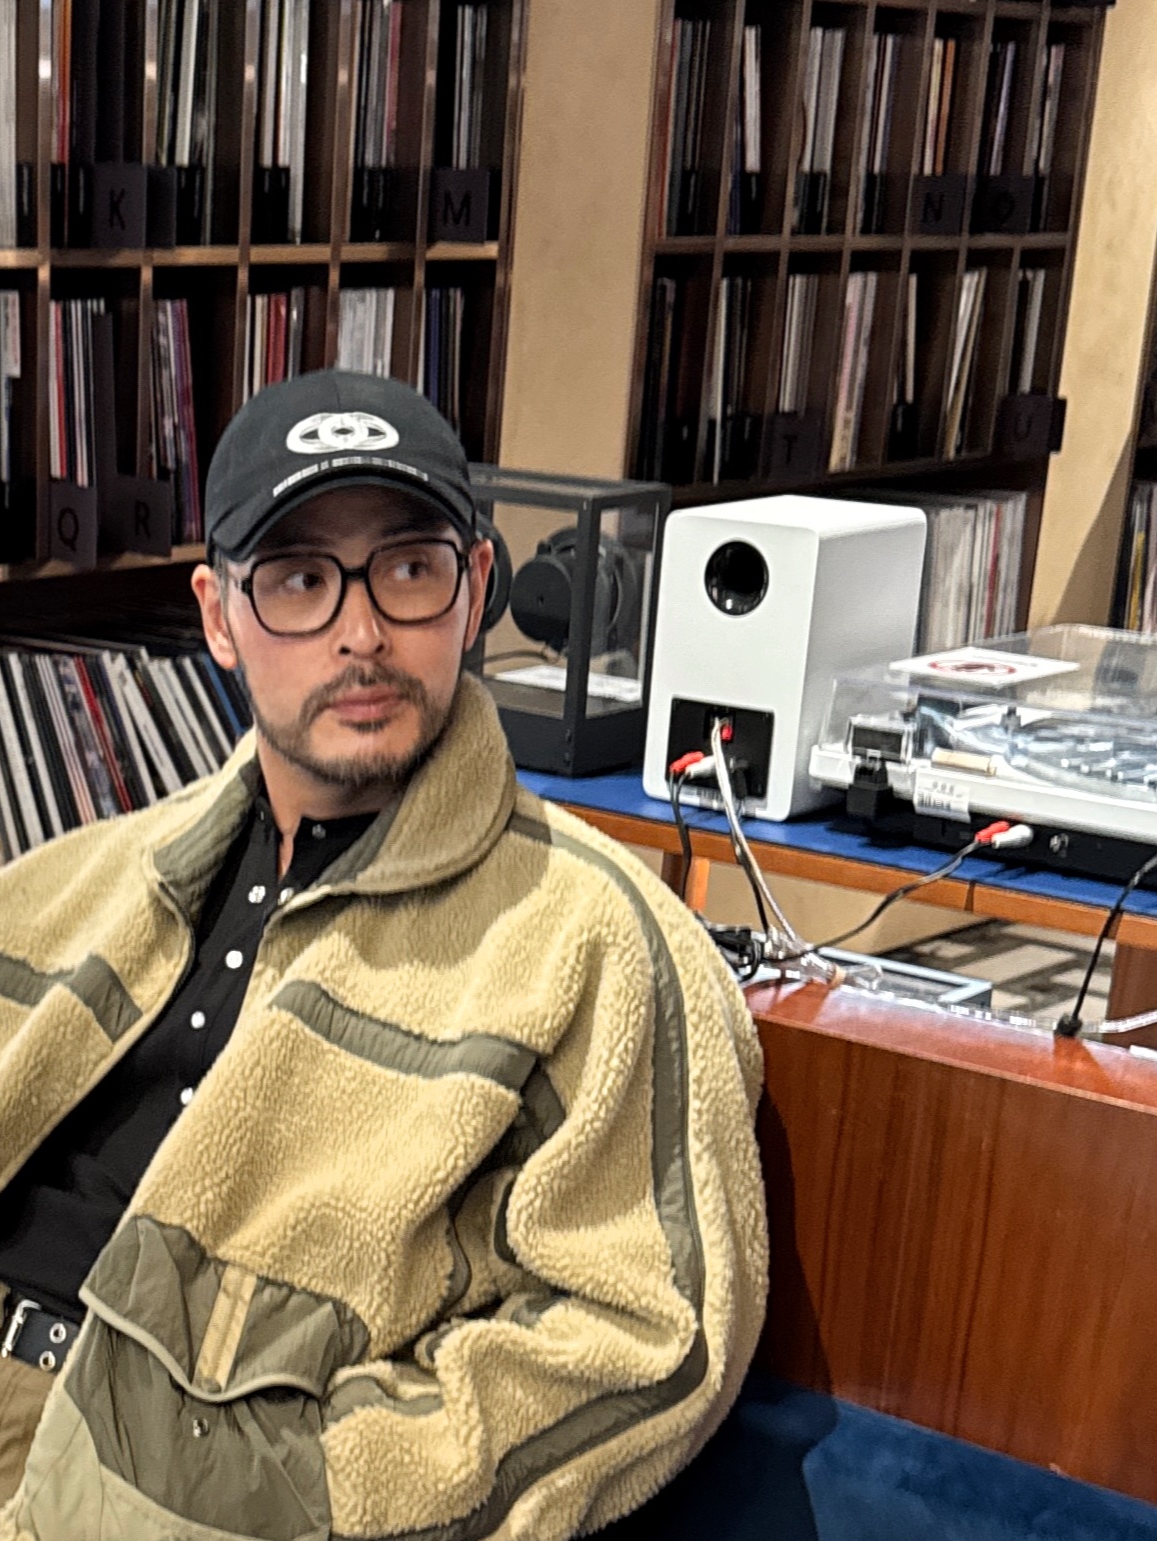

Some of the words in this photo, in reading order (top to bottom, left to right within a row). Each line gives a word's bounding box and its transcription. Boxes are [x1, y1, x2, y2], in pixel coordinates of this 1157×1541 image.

[109, 187, 126, 230] K
[442, 189, 473, 227] M
[57, 507, 80, 552] Q
[134, 501, 151, 538] R
